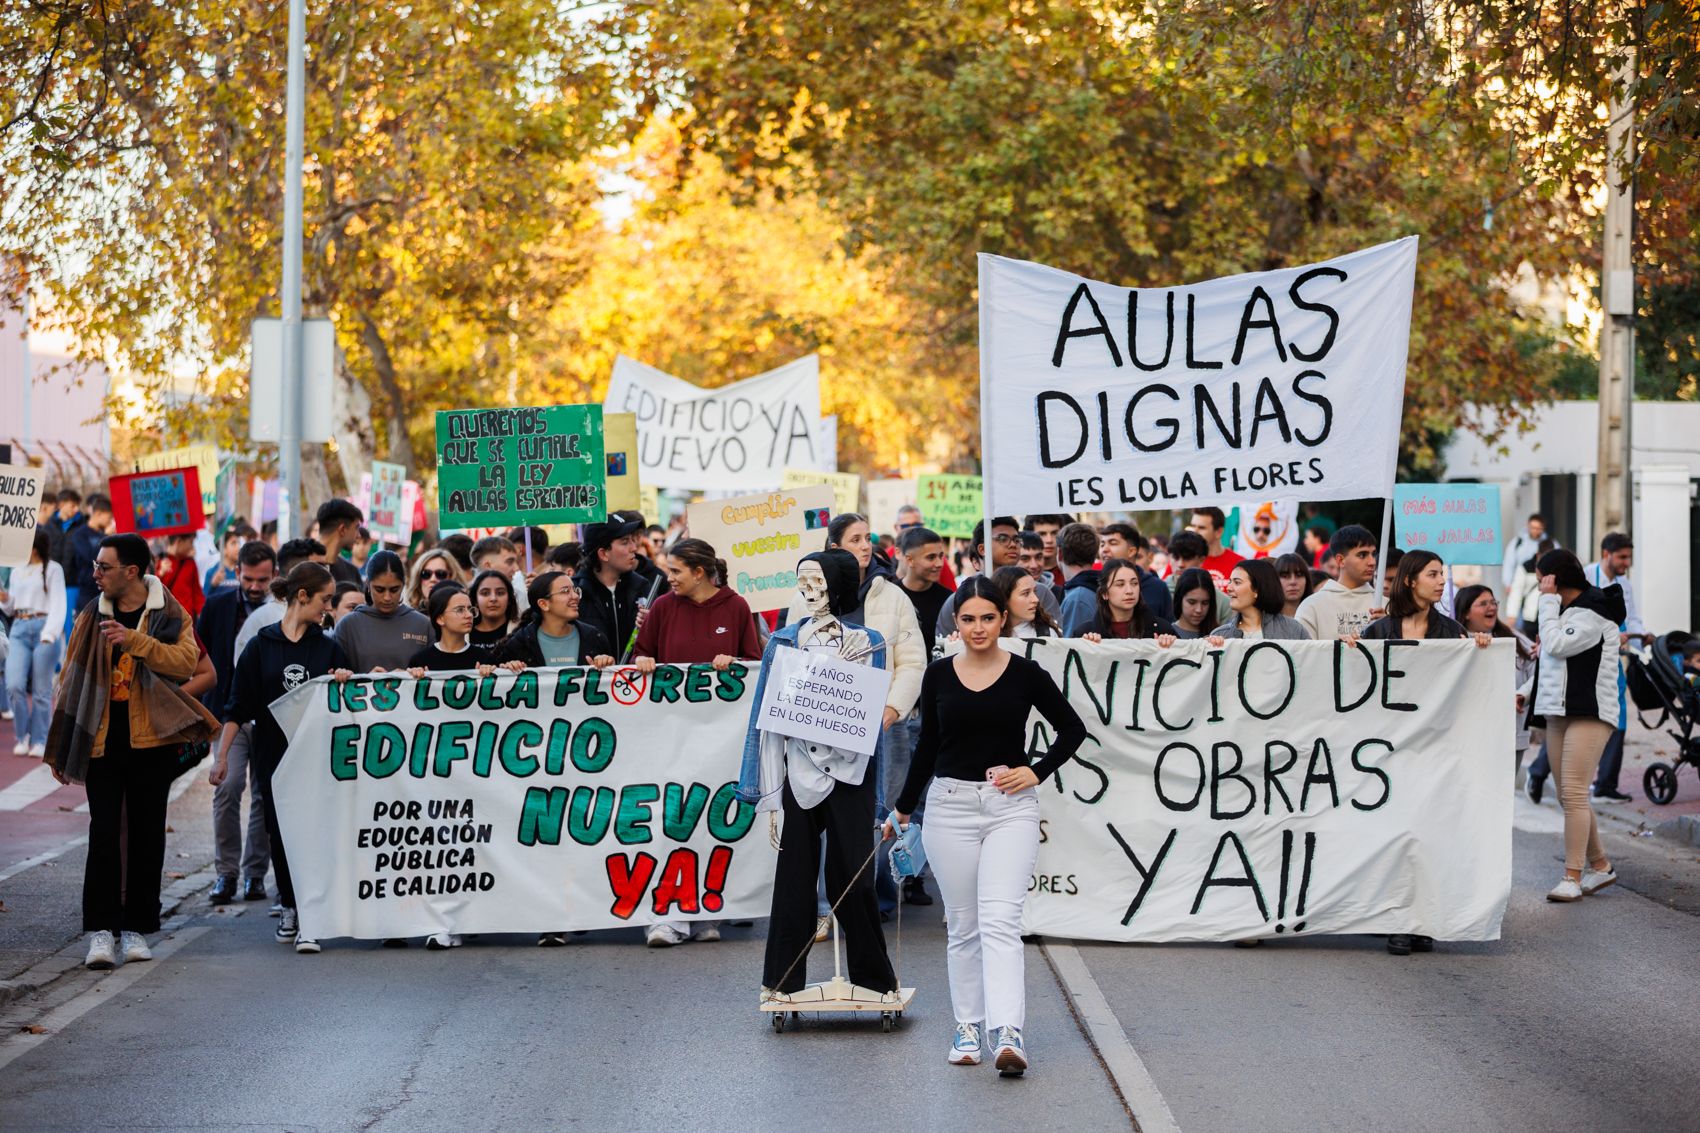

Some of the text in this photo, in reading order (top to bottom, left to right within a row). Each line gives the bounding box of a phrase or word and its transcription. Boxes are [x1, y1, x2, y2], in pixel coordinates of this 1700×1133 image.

[1052, 266, 1348, 371] AULAS
[623, 381, 752, 432] EDIFICIO
[1036, 369, 1333, 469] DIGNAS
[448, 407, 548, 439] QUEREMOS
[760, 401, 815, 468] YA
[443, 434, 581, 465] QUE SE CUMPLE
[636, 430, 747, 473] UEVO
[479, 463, 554, 488] LA LEY
[926, 480, 948, 500] 14
[1058, 457, 1325, 507] IES LOLA FLORES
[448, 488, 508, 513] AULAS
[721, 494, 797, 526] Cumplir
[1403, 496, 1487, 515] MÁS AULAS
[1405, 528, 1495, 547] NO JAULAS
[328, 678, 402, 713] IES
[413, 670, 539, 712] LOLA
[788, 677, 863, 703] ESPERANDO
[819, 668, 854, 685] AÑOS
[1334, 640, 1420, 713] DE
[777, 691, 867, 720] LA EDUCACIÓN
[769, 706, 867, 738] EN LOS HUESOS
[330, 717, 617, 781] EDIFICIO
[1153, 737, 1395, 820] OBRAS
[373, 799, 473, 821] POR UNA
[518, 781, 757, 846] NUEVO
[358, 819, 493, 848] EDUCACIÓN
[375, 845, 475, 872] PÚBLICA
[358, 872, 495, 900] DE CALIDAD
[606, 846, 733, 920] YA!
[1107, 822, 1316, 932] YA!!
